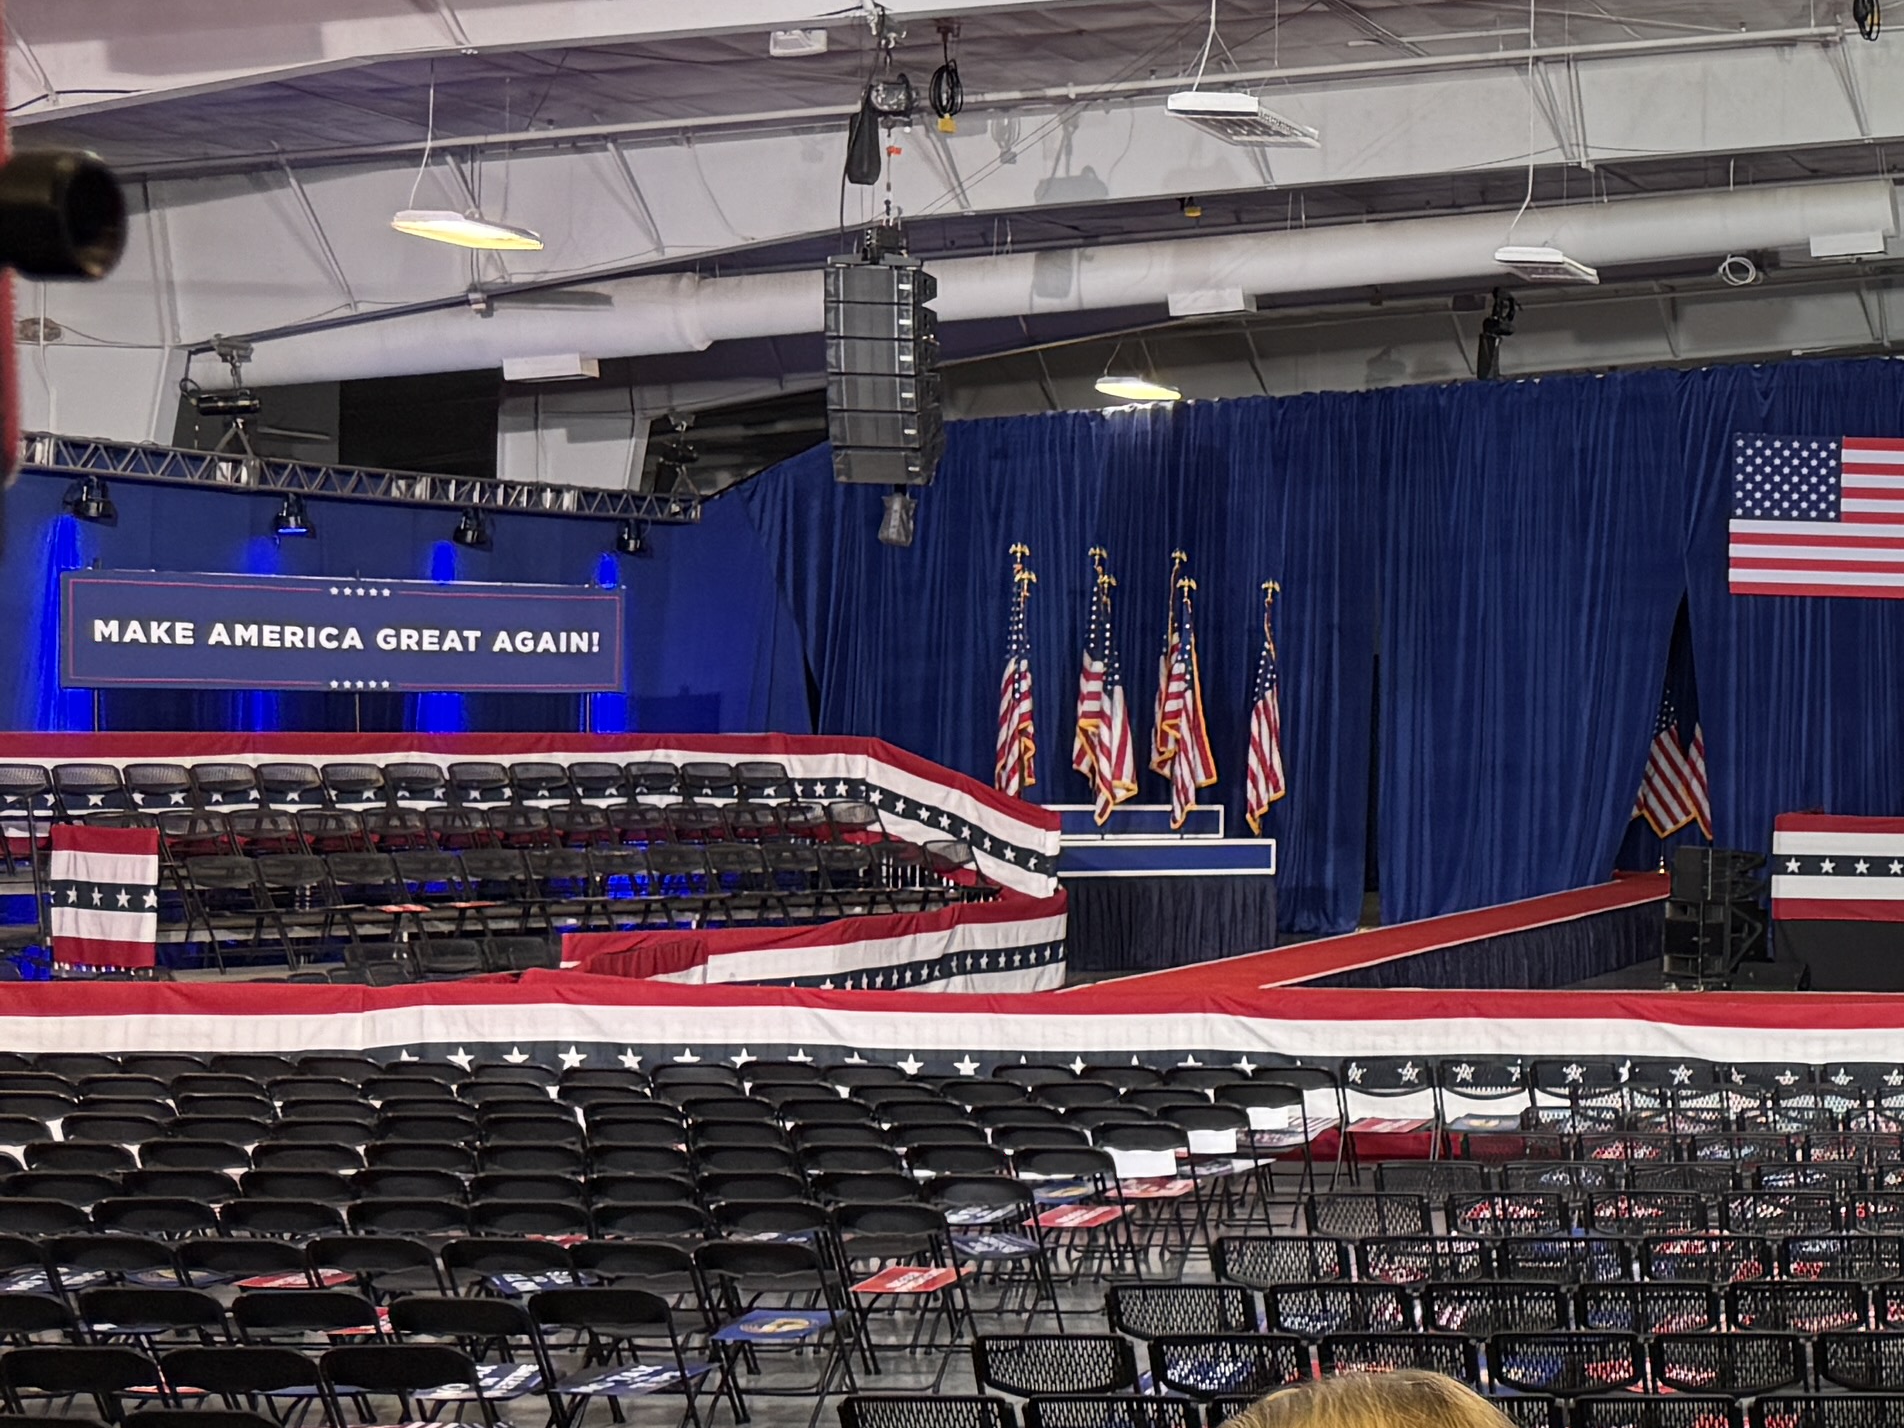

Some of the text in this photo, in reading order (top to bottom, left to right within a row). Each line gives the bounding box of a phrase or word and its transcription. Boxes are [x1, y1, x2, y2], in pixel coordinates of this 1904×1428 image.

[94, 618, 601, 654] MAKE AMERICA GREAT AGAIN!
